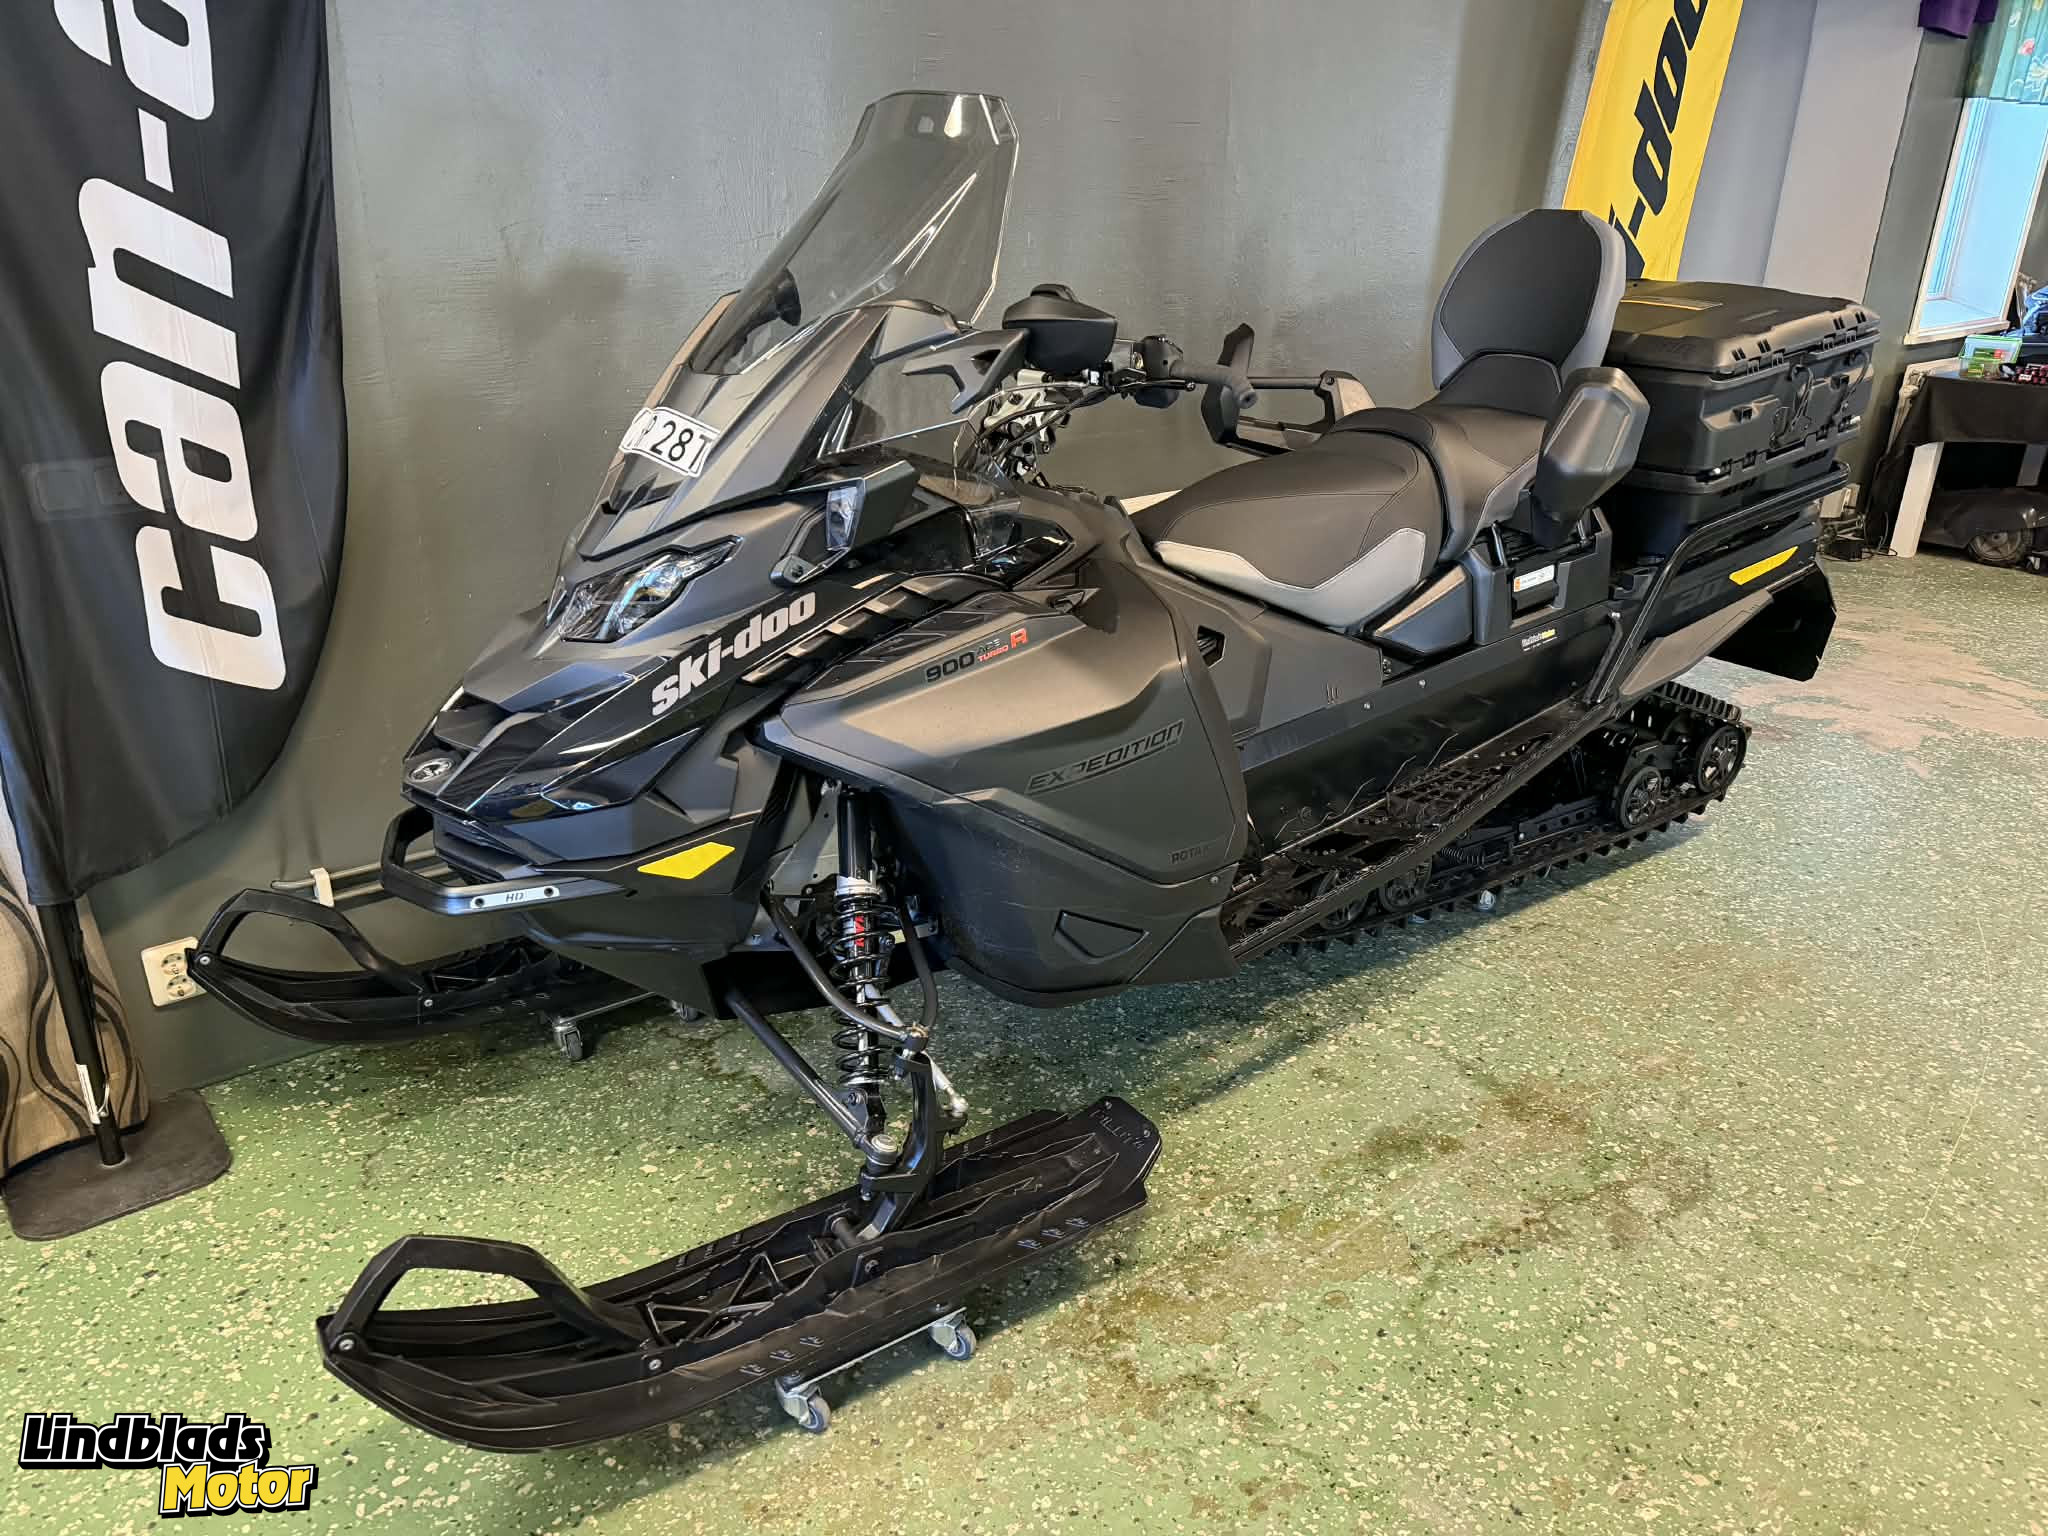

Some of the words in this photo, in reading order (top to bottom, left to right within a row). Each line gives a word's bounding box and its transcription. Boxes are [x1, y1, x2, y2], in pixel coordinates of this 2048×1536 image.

[652, 592, 816, 716] ski-doo
[926, 651, 975, 682] 900
[978, 644, 1009, 662] TURBO
[1010, 627, 1027, 649] R
[1028, 720, 1184, 791] EXPEDITION
[1171, 845, 1211, 865] ROTA
[506, 892, 524, 902] HD
